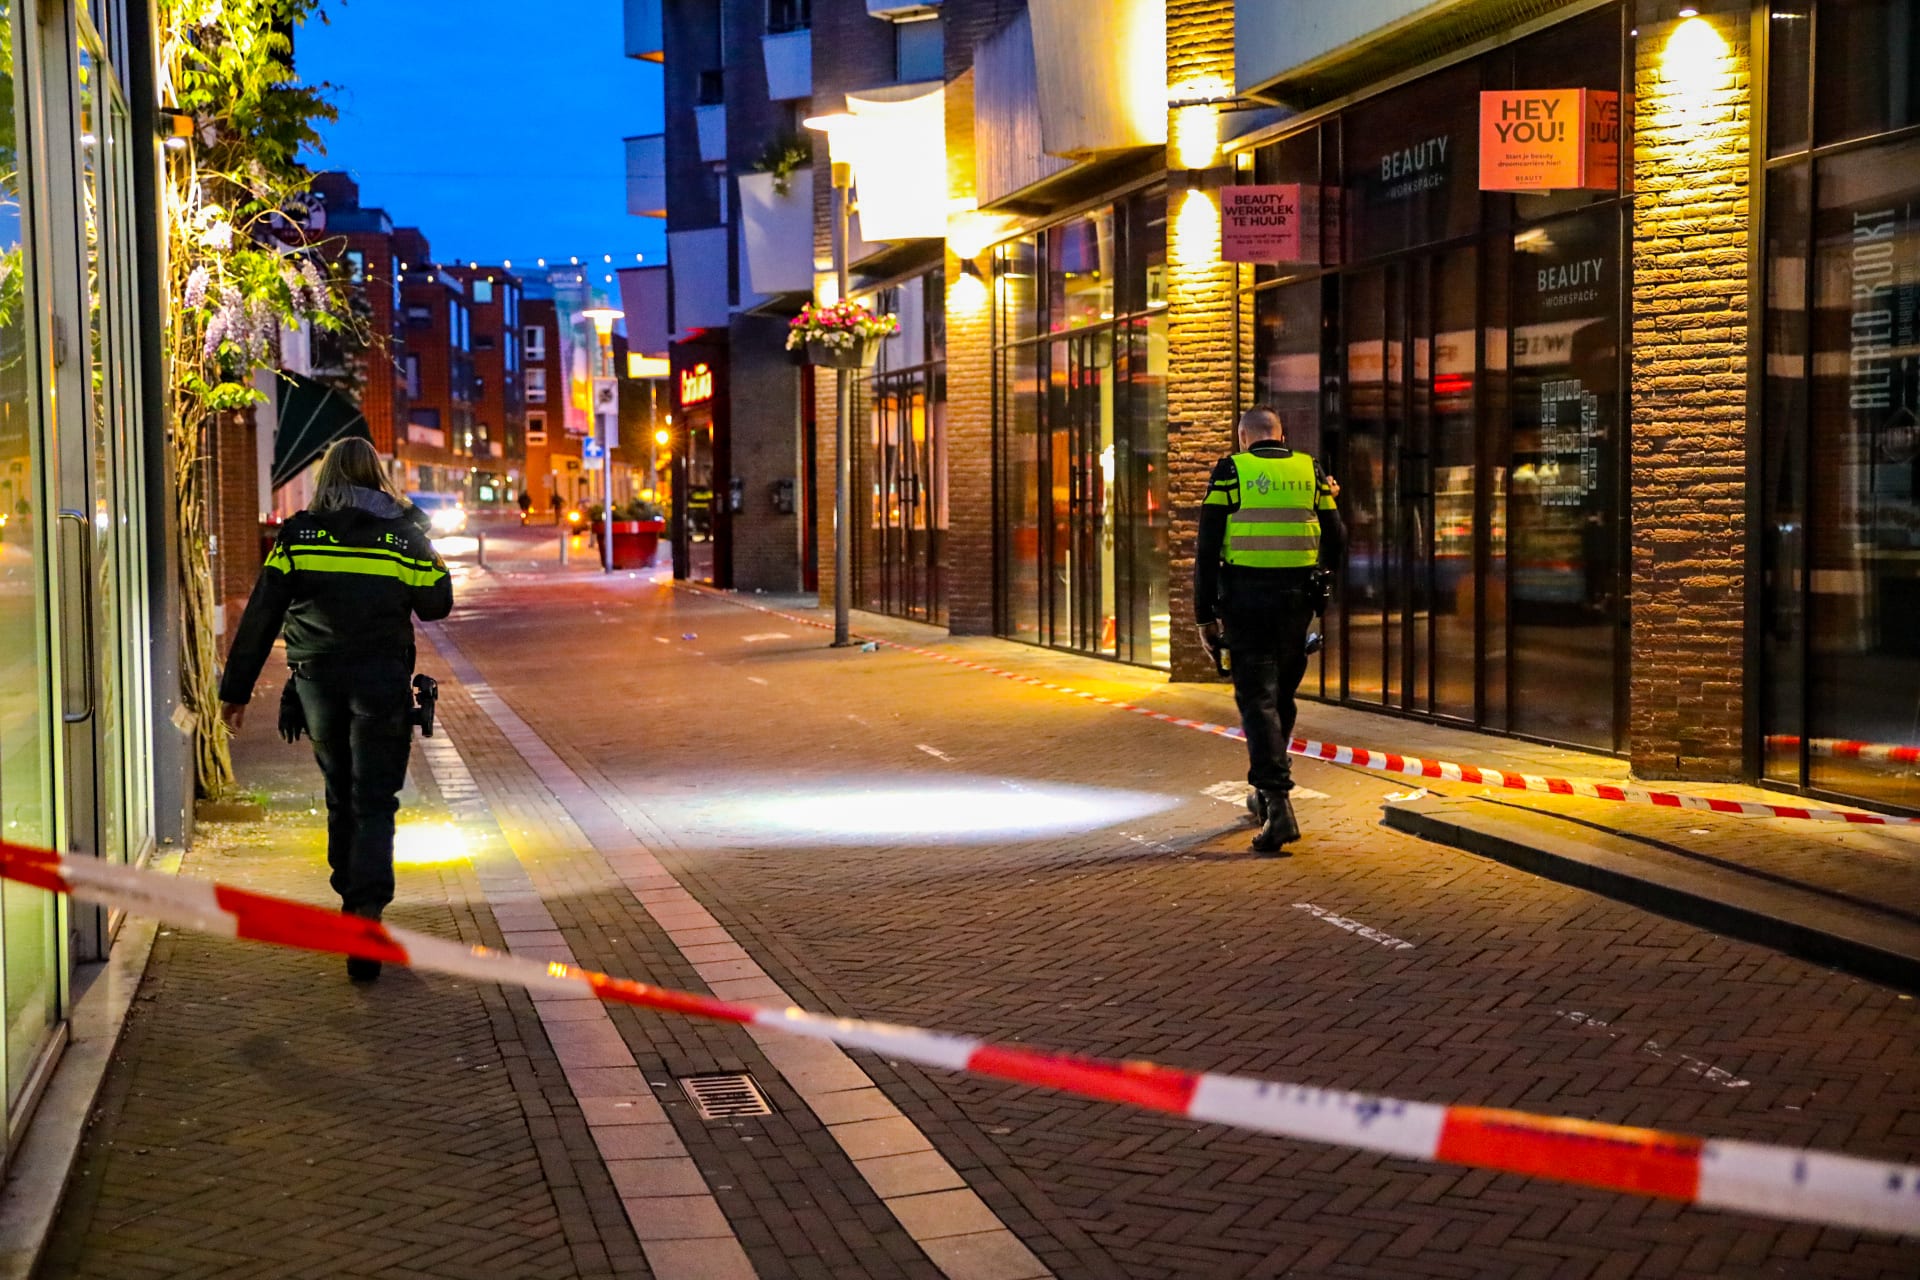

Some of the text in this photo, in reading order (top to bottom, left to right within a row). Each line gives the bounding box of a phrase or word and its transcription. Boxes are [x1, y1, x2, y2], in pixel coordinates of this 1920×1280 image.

[1502, 99, 1560, 121] HEY
[1494, 121, 1565, 143] YOU!
[1382, 135, 1448, 181] BEAUTY
[1530, 153, 1554, 161] beauty
[1224, 204, 1294, 216] WERKPLEK
[1234, 194, 1284, 205] BEAUTY
[1232, 216, 1287, 226] TE HUUR
[1537, 257, 1603, 292] BEAUTY
[1849, 209, 1895, 409] ALFRED KOOKT
[1246, 475, 1312, 495] POLITIE
